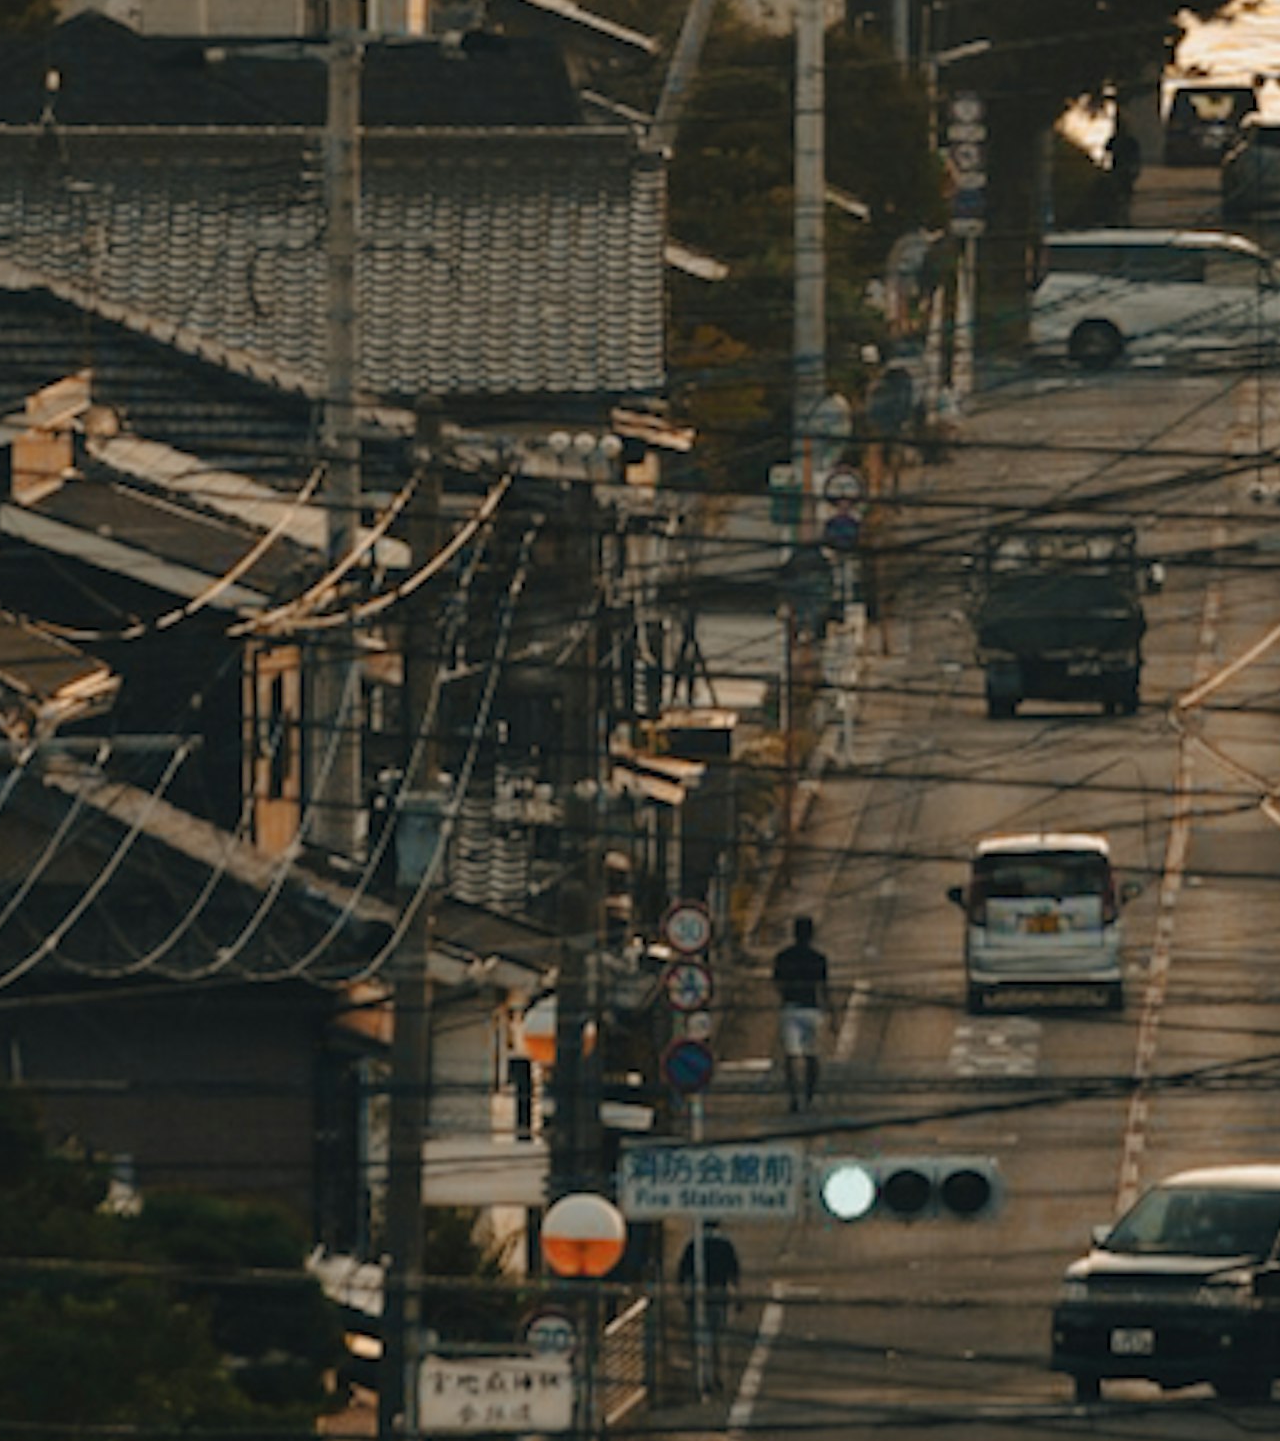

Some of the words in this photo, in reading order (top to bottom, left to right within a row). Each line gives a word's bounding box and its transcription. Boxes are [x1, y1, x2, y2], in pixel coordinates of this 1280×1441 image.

[629, 1150, 792, 1185] 消防会館前
[635, 1188, 671, 1206] Fire
[679, 1188, 742, 1207] Station
[750, 1190, 787, 1207] Hall
